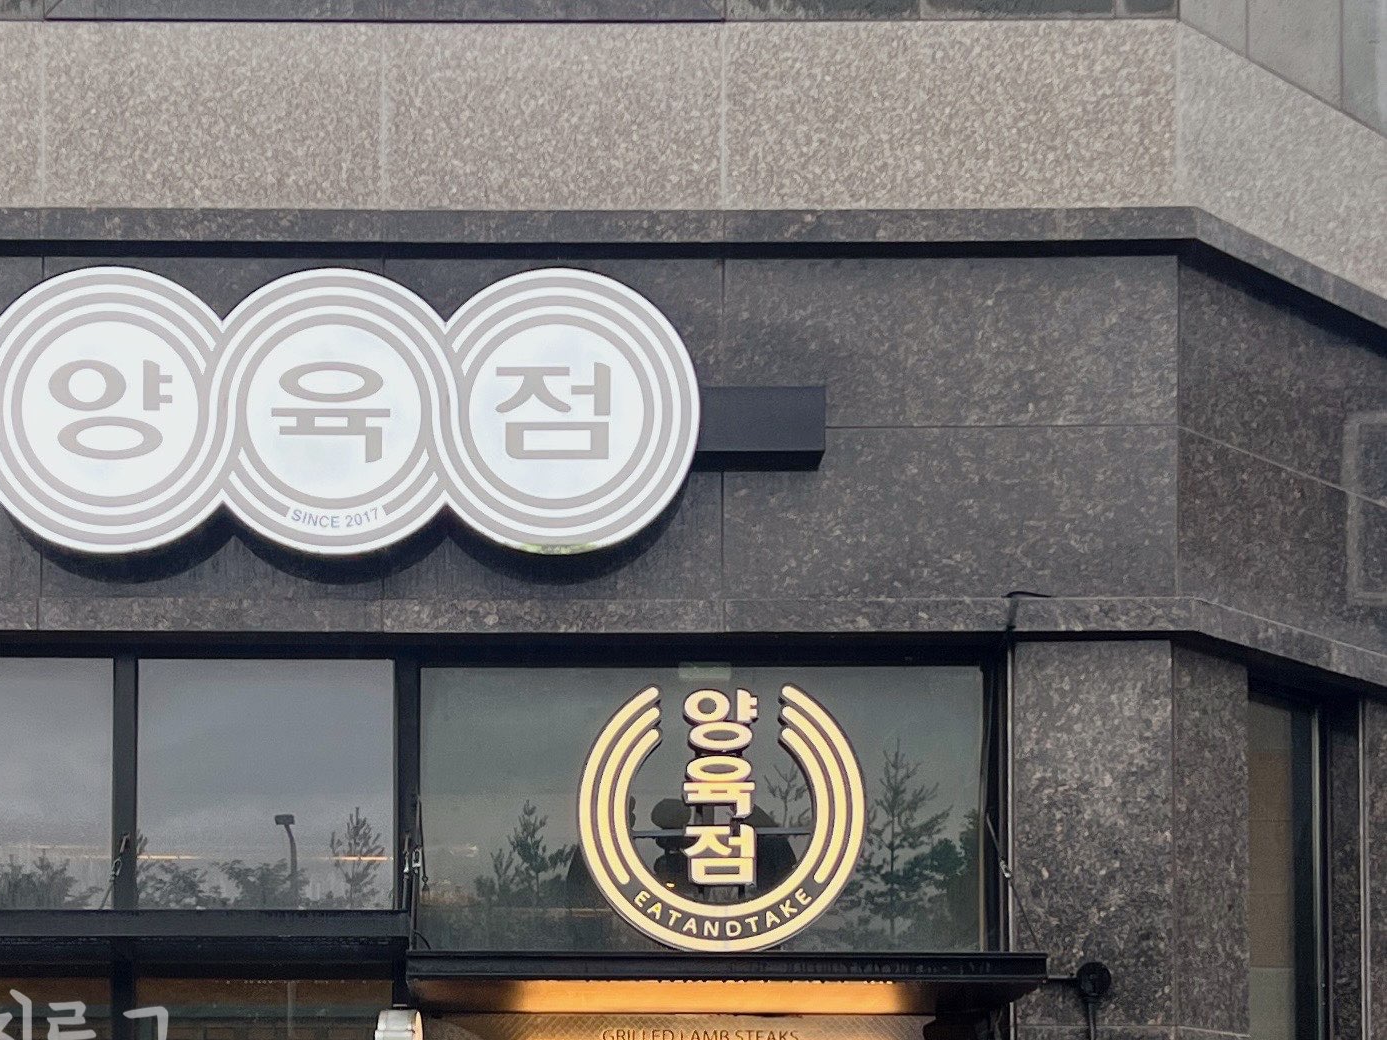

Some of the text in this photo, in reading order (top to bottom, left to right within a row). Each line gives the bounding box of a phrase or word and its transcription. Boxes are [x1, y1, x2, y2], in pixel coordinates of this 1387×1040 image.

[48, 359, 612, 464] 양육점
[290, 506, 379, 529] SINCE 2017
[683, 688, 759, 886] 양육점
[632, 887, 814, 939] EATANDTAKE
